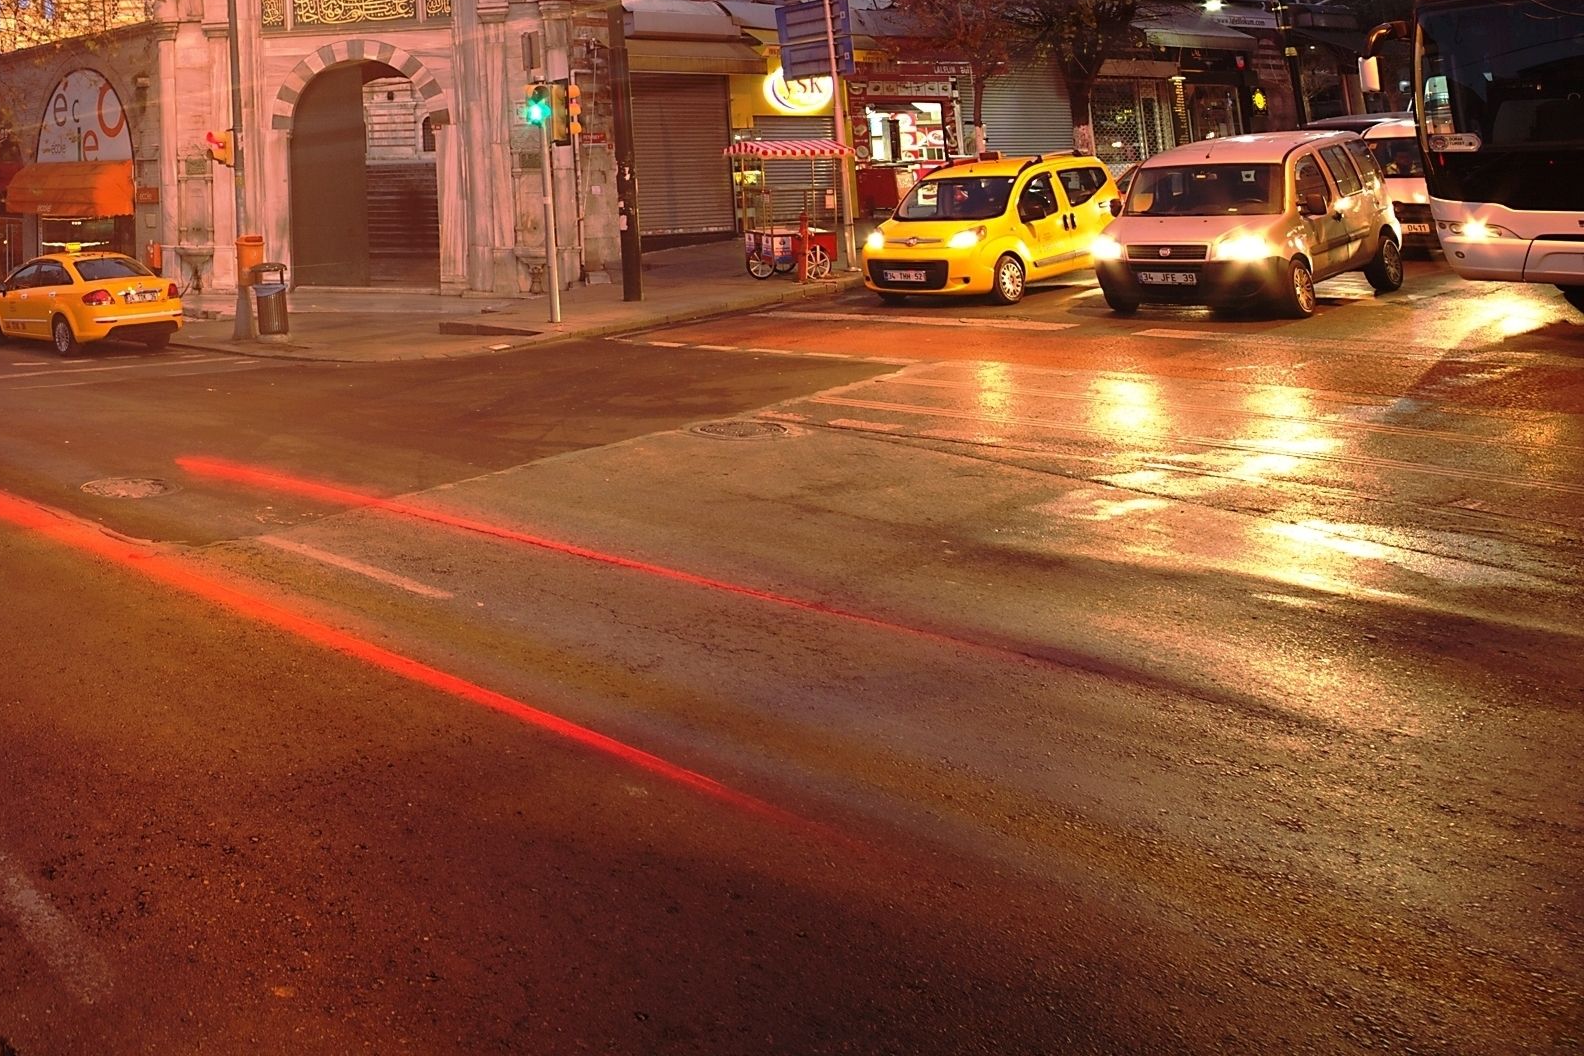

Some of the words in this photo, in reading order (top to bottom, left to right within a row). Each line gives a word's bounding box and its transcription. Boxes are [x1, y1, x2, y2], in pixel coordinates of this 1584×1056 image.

[1407, 224, 1427, 232] 0411
[888, 272, 896, 280] 34
[914, 272, 923, 280] 52
[1142, 273, 1154, 281] 34
[1160, 273, 1177, 282] JFE
[1182, 273, 1194, 282] 39
